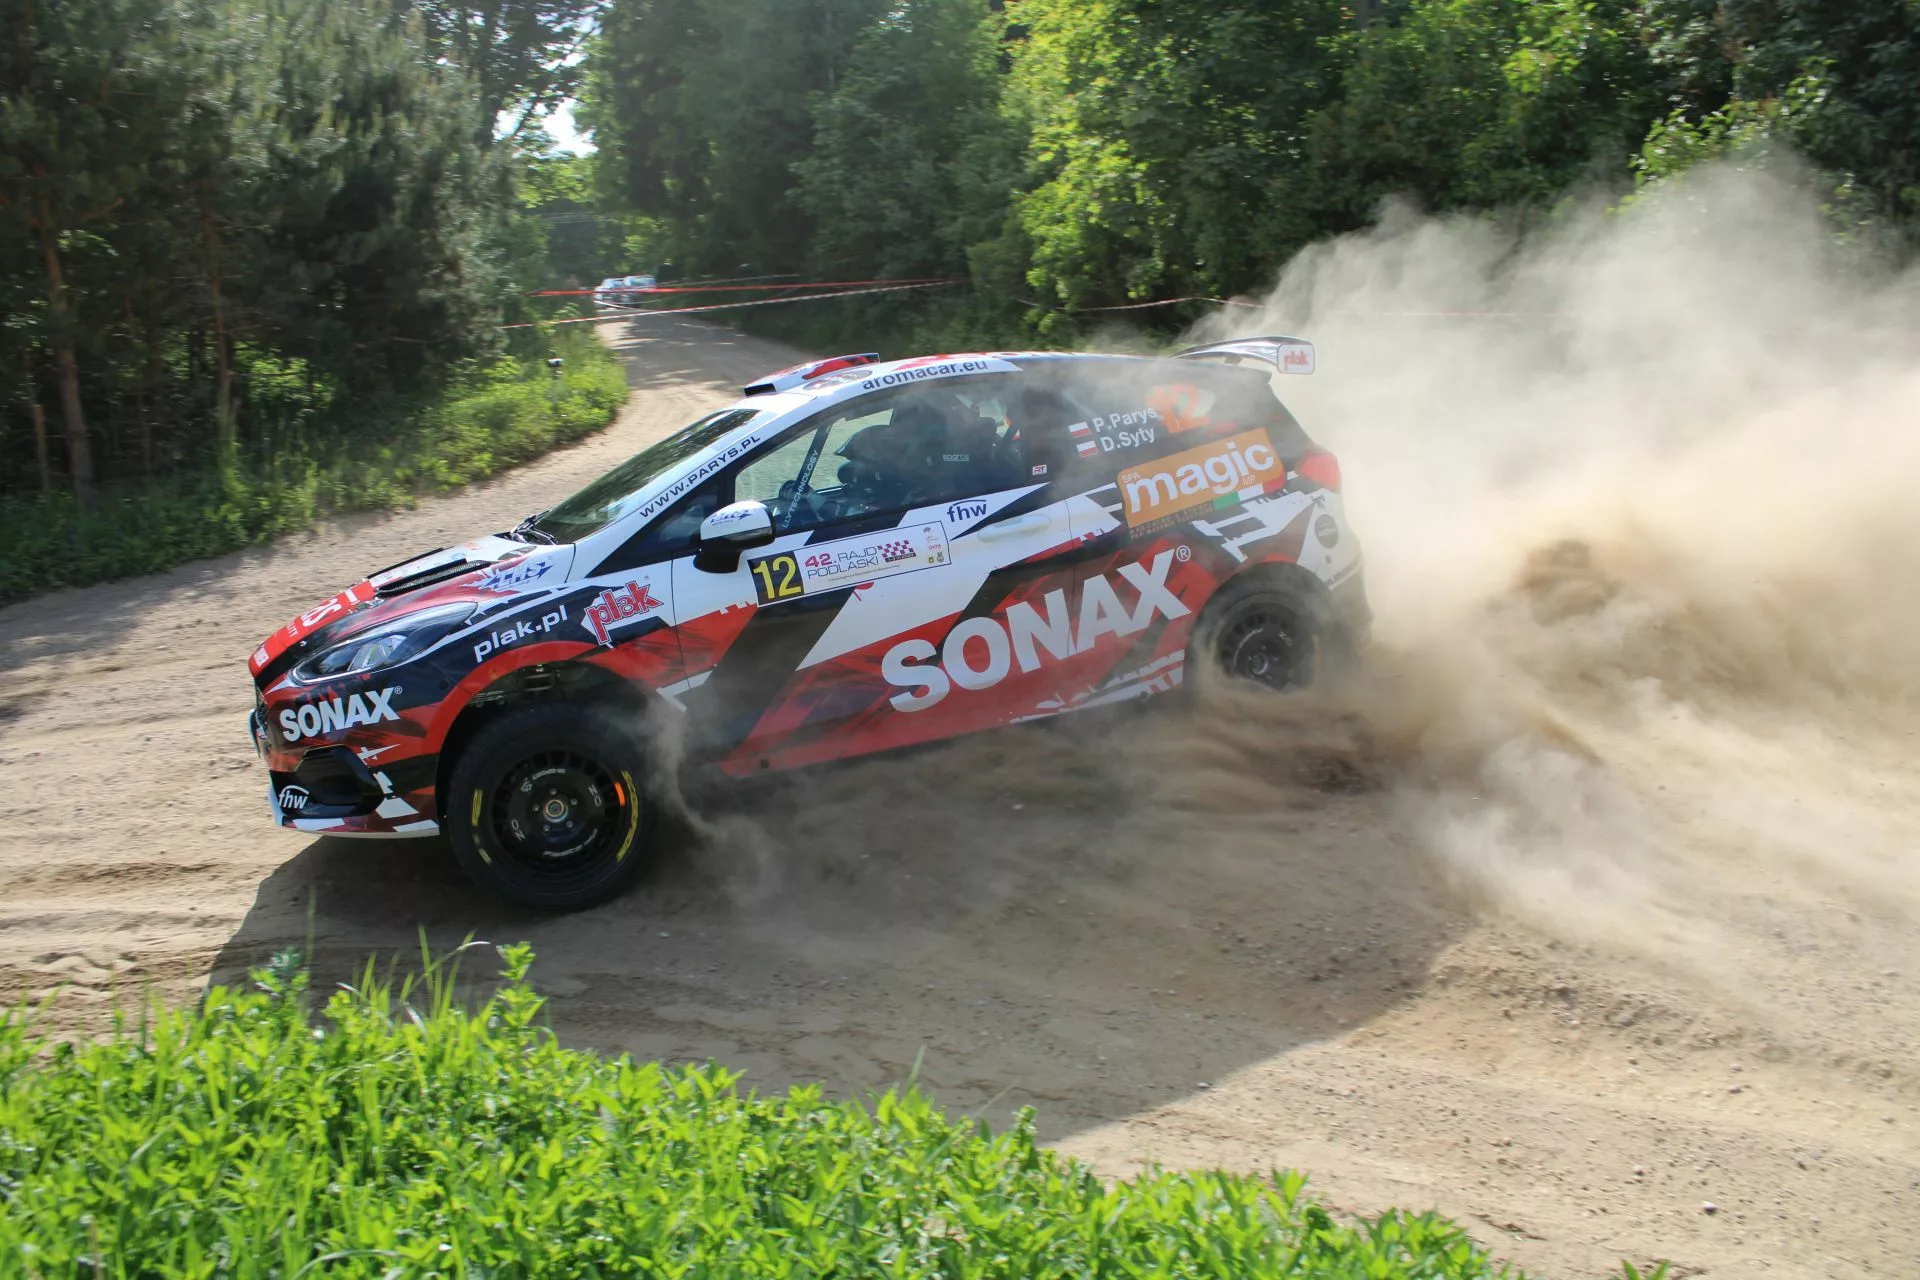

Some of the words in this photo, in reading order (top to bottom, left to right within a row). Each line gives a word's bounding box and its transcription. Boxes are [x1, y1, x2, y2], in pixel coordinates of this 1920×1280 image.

[862, 361, 988, 390] aromacar.eu
[1100, 428, 1155, 452] D.Syty
[640, 436, 761, 518] WWW.PARYS.PL
[1125, 442, 1275, 513] magic
[946, 500, 987, 523] fhw
[838, 546, 878, 560] RAJD
[753, 555, 802, 599] 12
[808, 557, 879, 579] PODLASKI
[584, 581, 664, 646] plak
[474, 604, 568, 663] plak.pl
[279, 785, 310, 809] fhw
